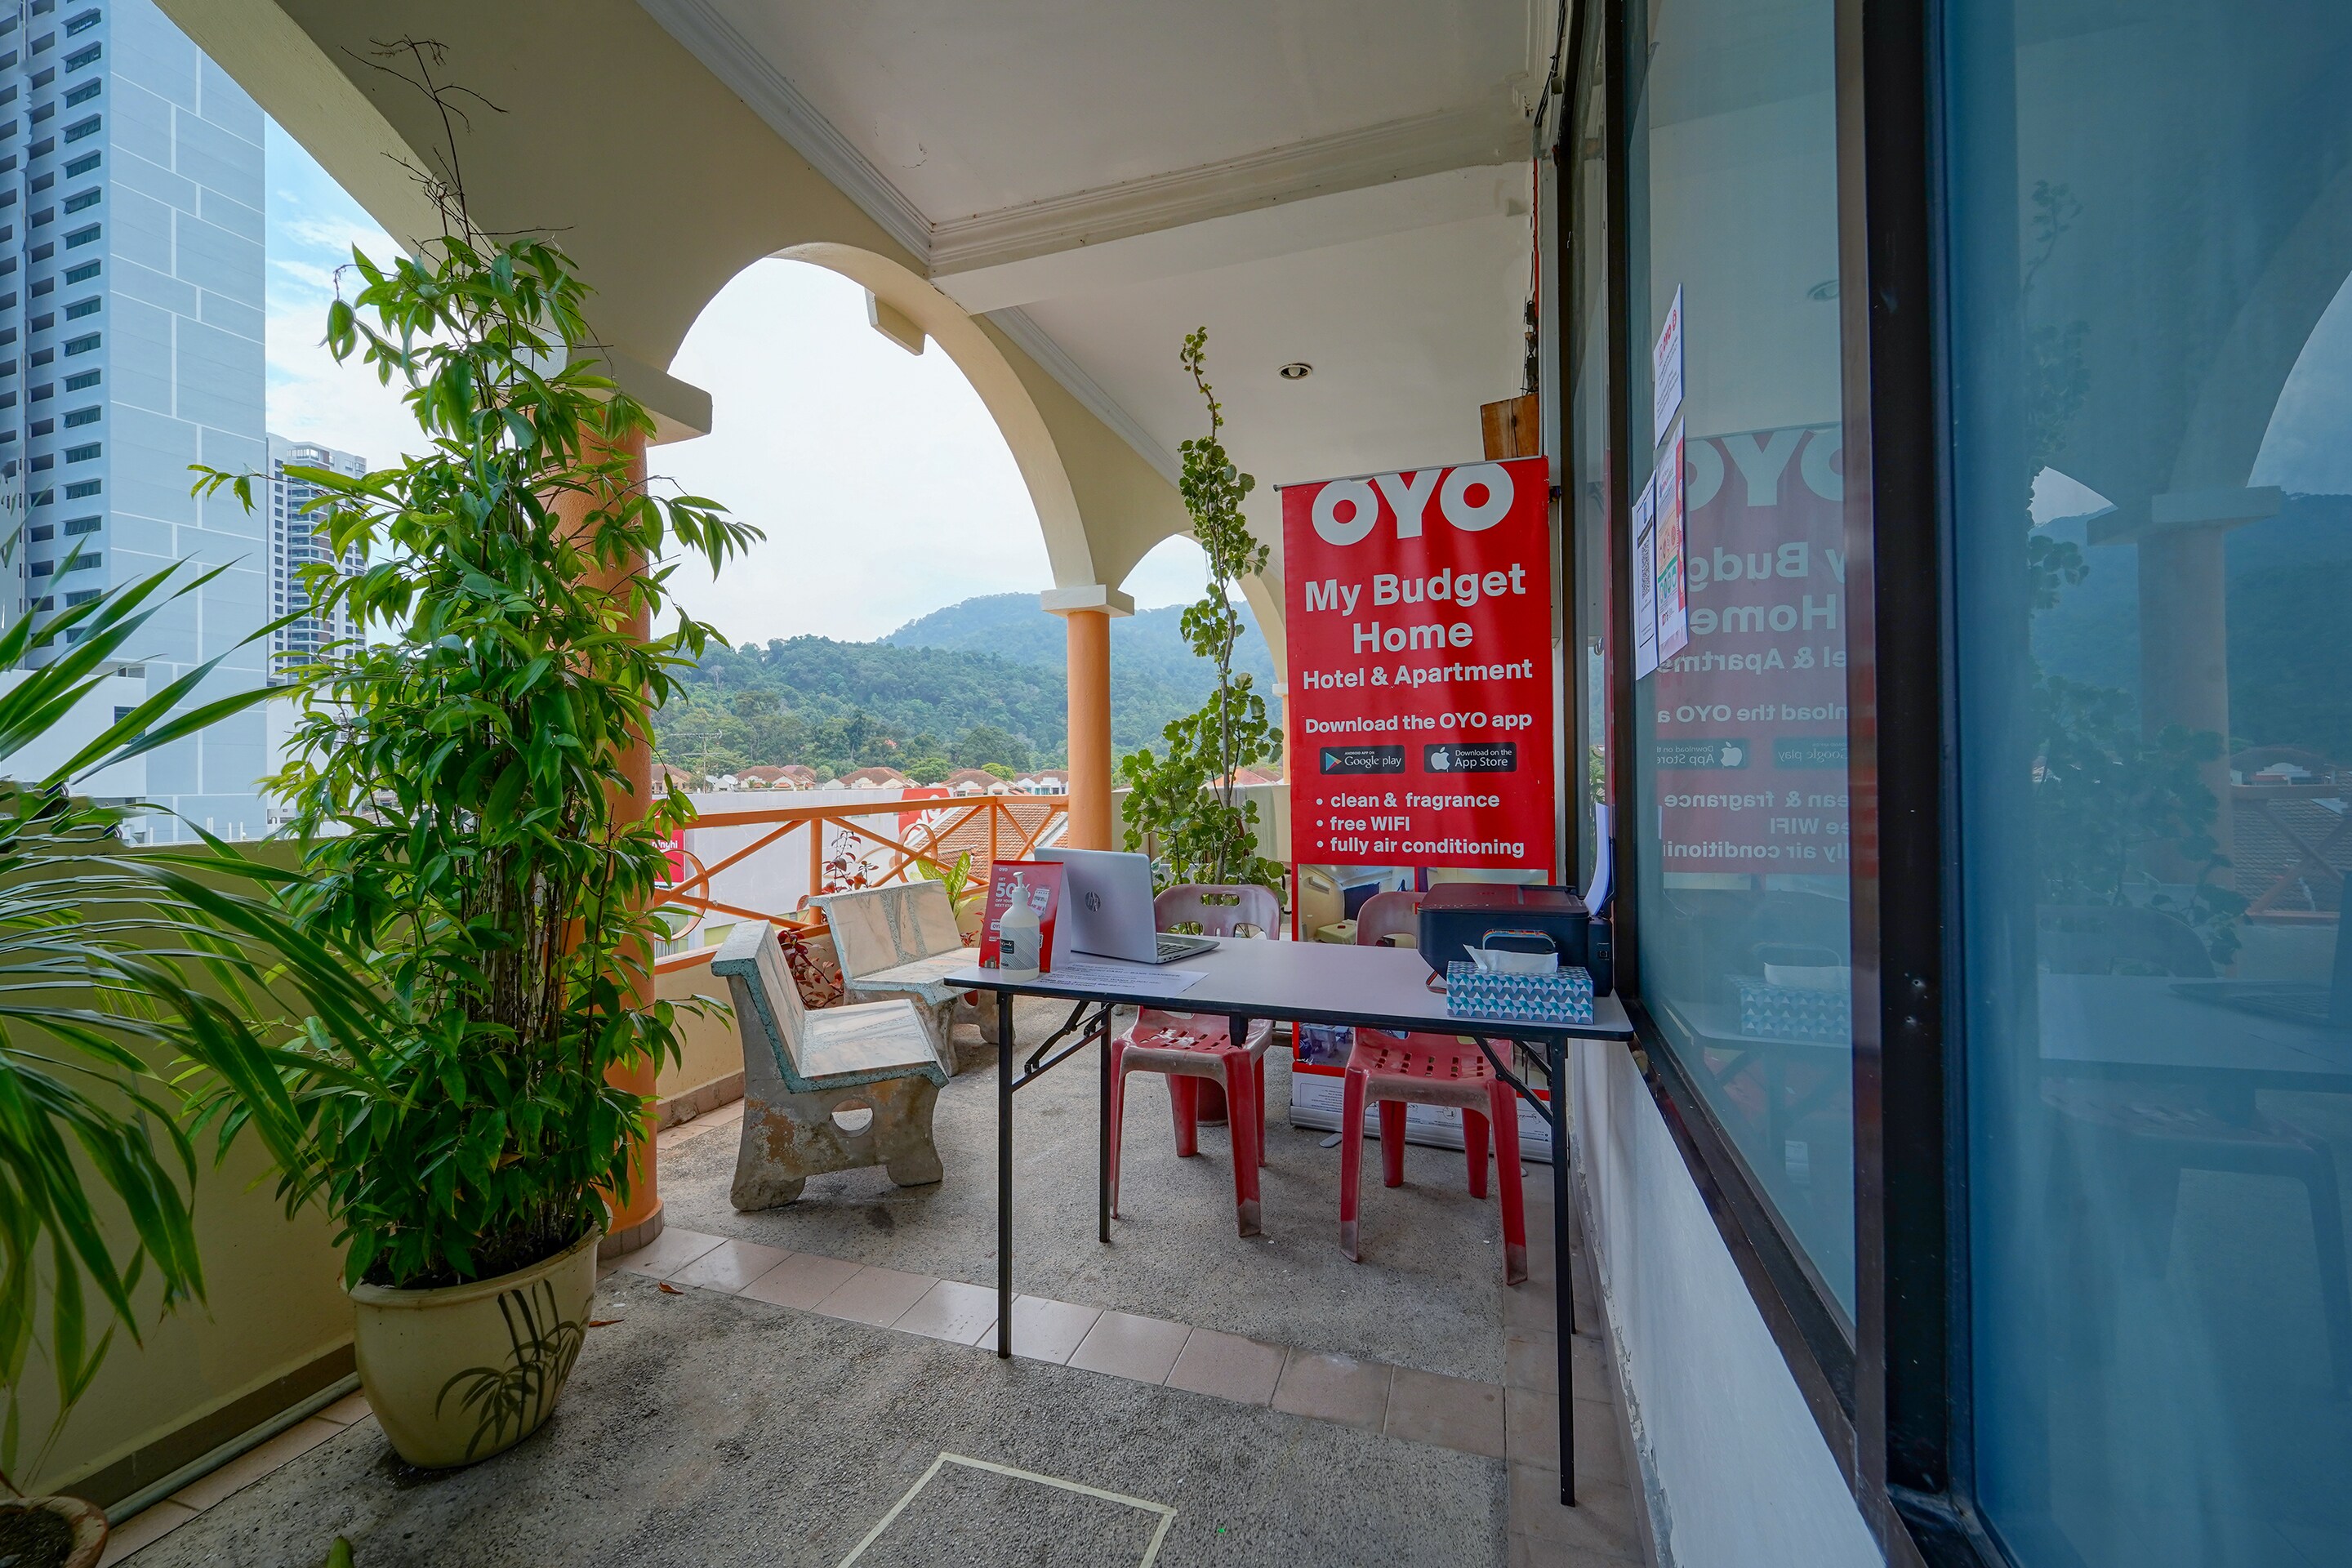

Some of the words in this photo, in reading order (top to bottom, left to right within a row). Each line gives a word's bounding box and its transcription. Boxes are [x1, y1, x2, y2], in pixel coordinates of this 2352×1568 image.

[1312, 464, 1514, 546] OYO
[1305, 579, 1361, 616] My
[1374, 563, 1526, 607] Budget
[1353, 621, 1473, 654] Home
[1303, 668, 1364, 689] Hotel
[1370, 666, 1389, 686] &
[1392, 659, 1533, 688] Apartment
[1306, 715, 1397, 733] Download
[1402, 715, 1435, 729] the
[1440, 712, 1486, 728] OYO
[1492, 713, 1532, 730] app
[1344, 755, 1379, 768] Google
[1382, 755, 1401, 767] play
[1455, 757, 1477, 768] App
[1480, 758, 1508, 766] Store
[1330, 793, 1379, 808] clean
[1383, 792, 1397, 808] &
[1405, 792, 1499, 811] fragrance
[1330, 817, 1366, 831] free
[1370, 816, 1410, 831] WIFI
[1330, 837, 1369, 855] fully
[1374, 838, 1397, 853] air
[1402, 839, 1524, 858] conditioning
